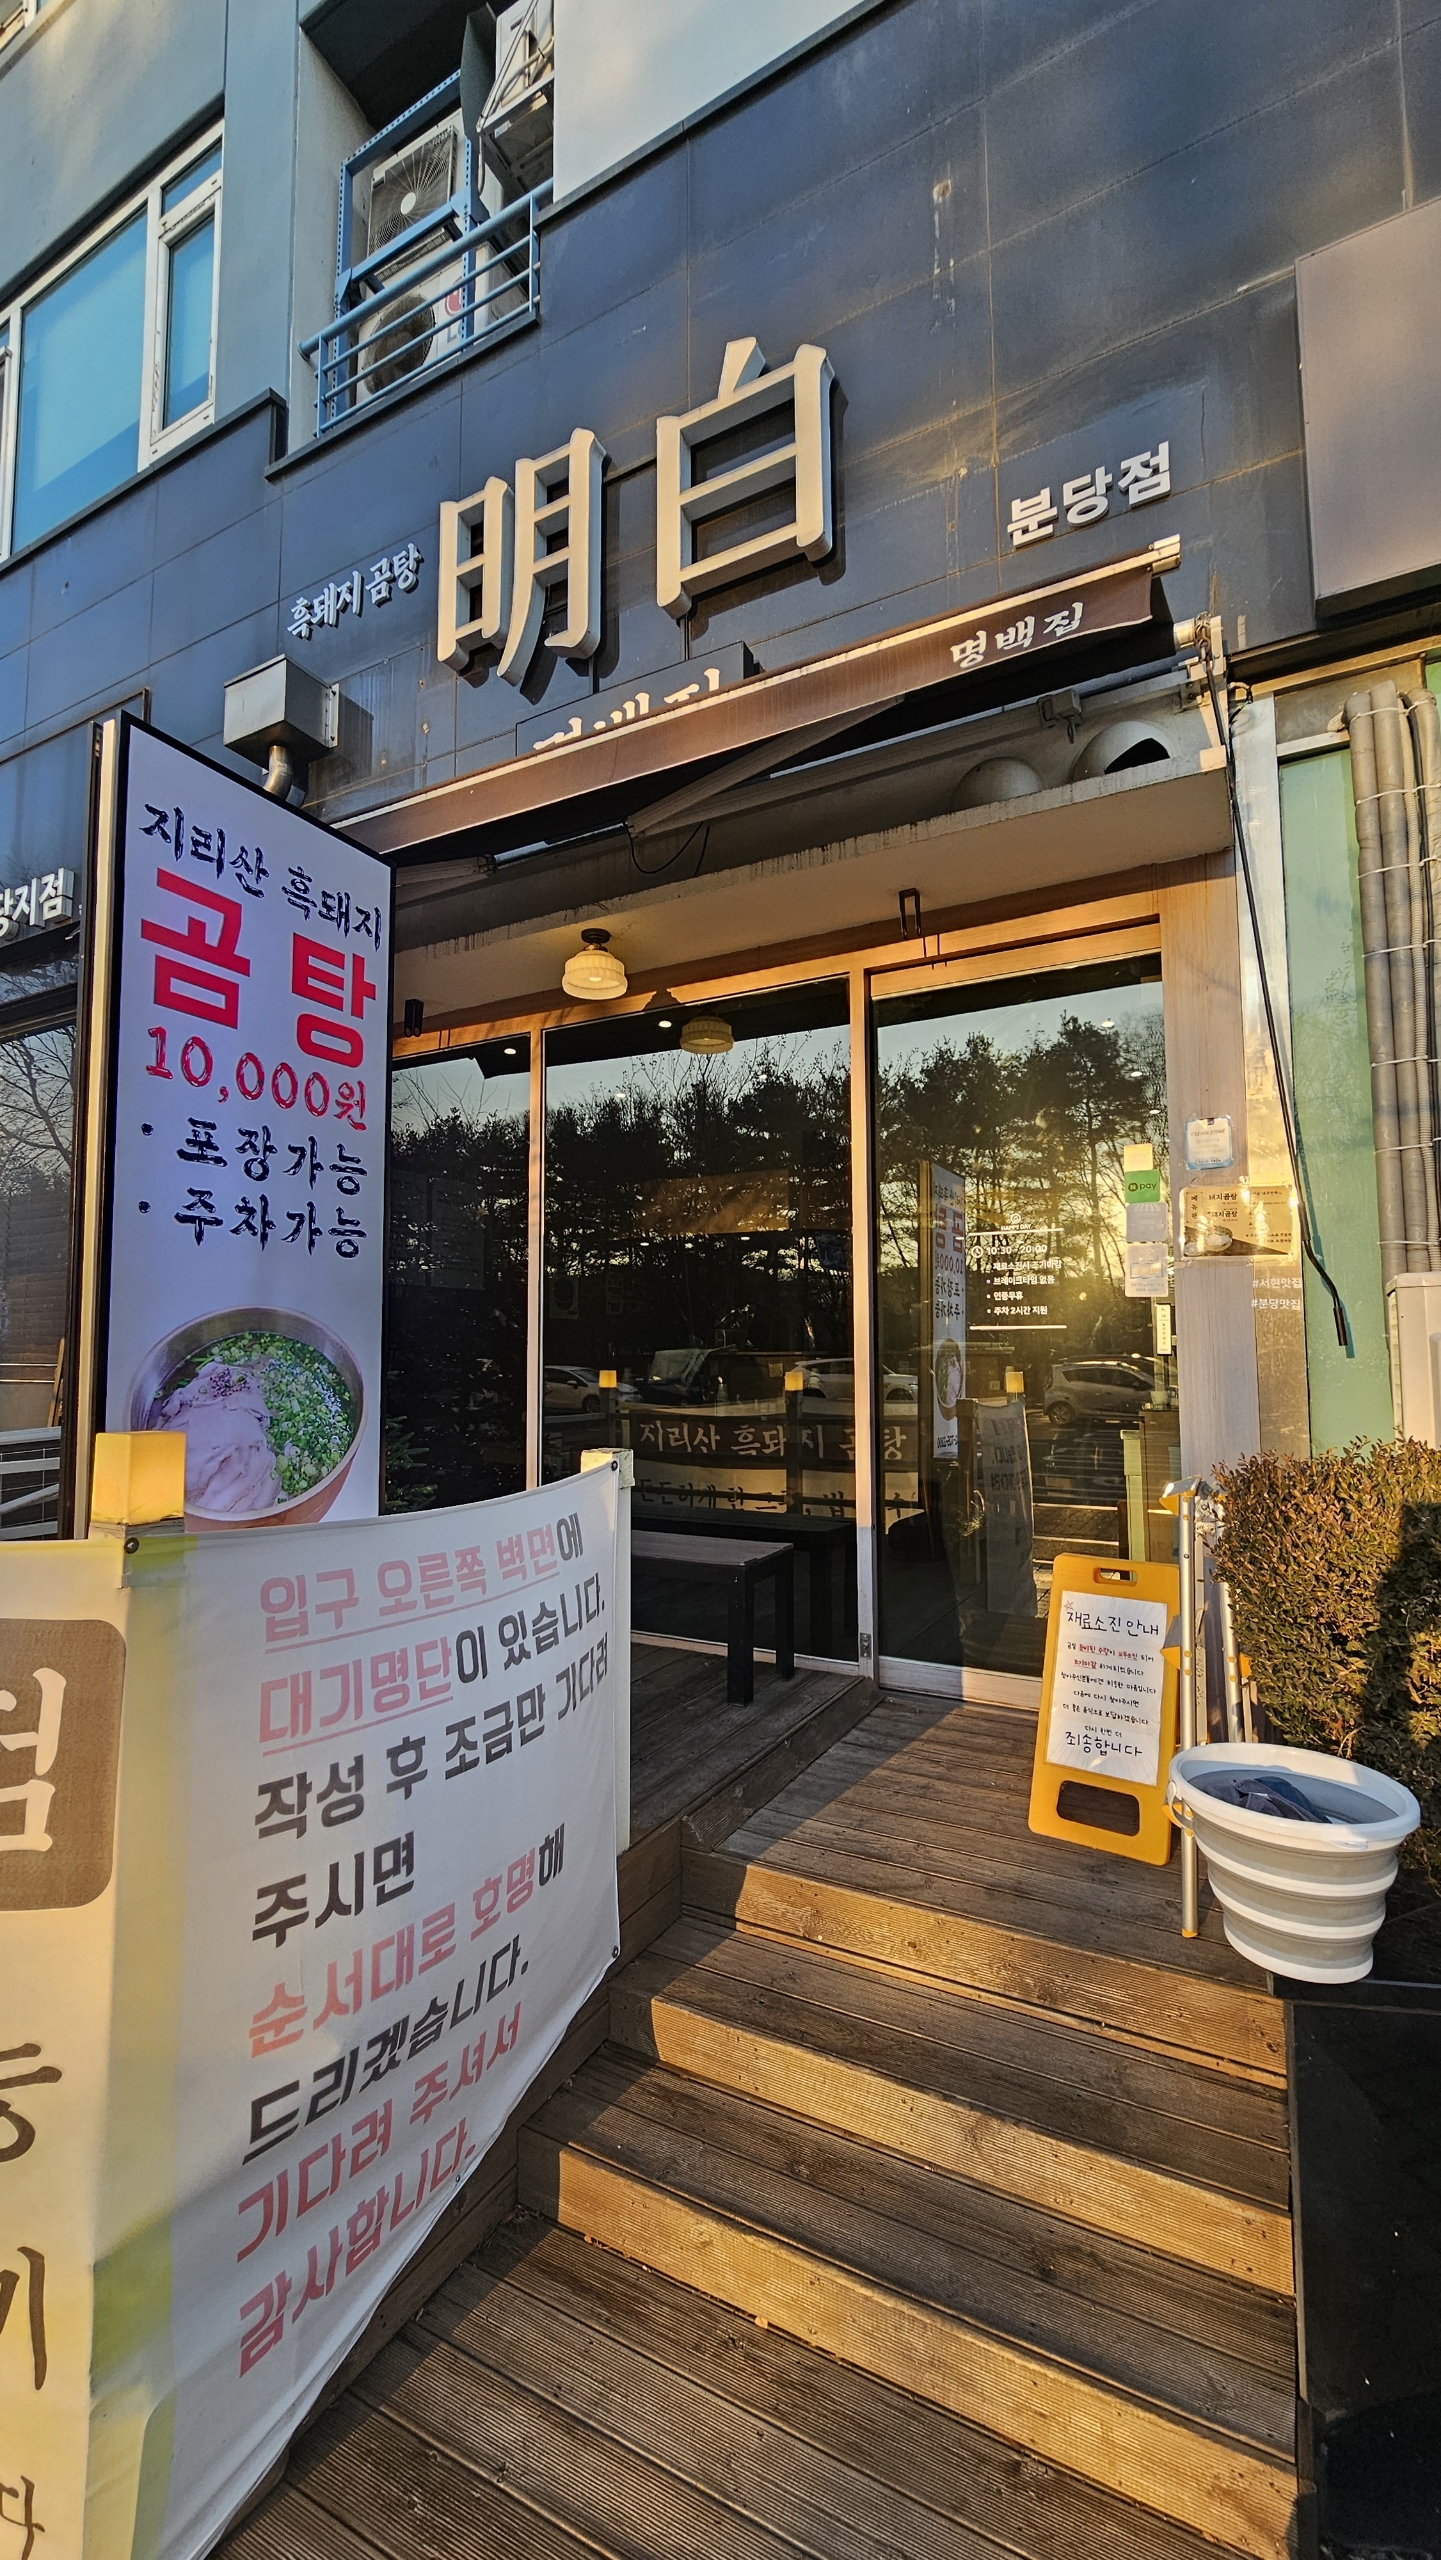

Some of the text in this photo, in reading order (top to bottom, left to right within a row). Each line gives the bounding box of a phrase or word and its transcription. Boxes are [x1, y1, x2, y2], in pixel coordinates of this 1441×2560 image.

[438, 336, 836, 688] 明白
[1007, 440, 1171, 548] 분당점
[287, 543, 422, 639] 흑돼지 곰탕
[950, 602, 1084, 669] 명백집
[139, 803, 382, 952] 지리산 흑돼지
[146, 1026, 367, 1132] 10,000원
[176, 1117, 368, 1196] 포장가능
[174, 1187, 367, 1260] 주차가능
[987, 1246, 1012, 1256] 10:30
[1020, 1245, 1048, 1254] 20:00
[993, 1275, 1056, 1286] 브레이크타임 없음
[993, 1291, 1024, 1301] 연중무휴
[993, 1305, 1048, 1316] 주차 2시간 지원
[1251, 1298, 1300, 1310] #분당맛집
[1252, 1277, 1302, 1289] #서현맛집
[640, 1420, 720, 1453] 지리산
[260, 1512, 584, 1643] 입구 오른쪽 벽면에
[1066, 1611, 1159, 1637] 재료소진 안내
[259, 1572, 606, 1743] 대기명단이 있습니다.
[255, 1632, 608, 1840] 작성 후 조금만 기다려
[1065, 1731, 1143, 1757] 죄송합니다
[252, 1830, 415, 1948] 주시면
[248, 1822, 565, 2059] 순서대로 호명해
[242, 1933, 529, 2167] 드리겠습니다.
[237, 2098, 393, 2264] 기다려
[410, 2002, 522, 2125] 주셔서
[239, 2116, 476, 2378] 감사합니다.
